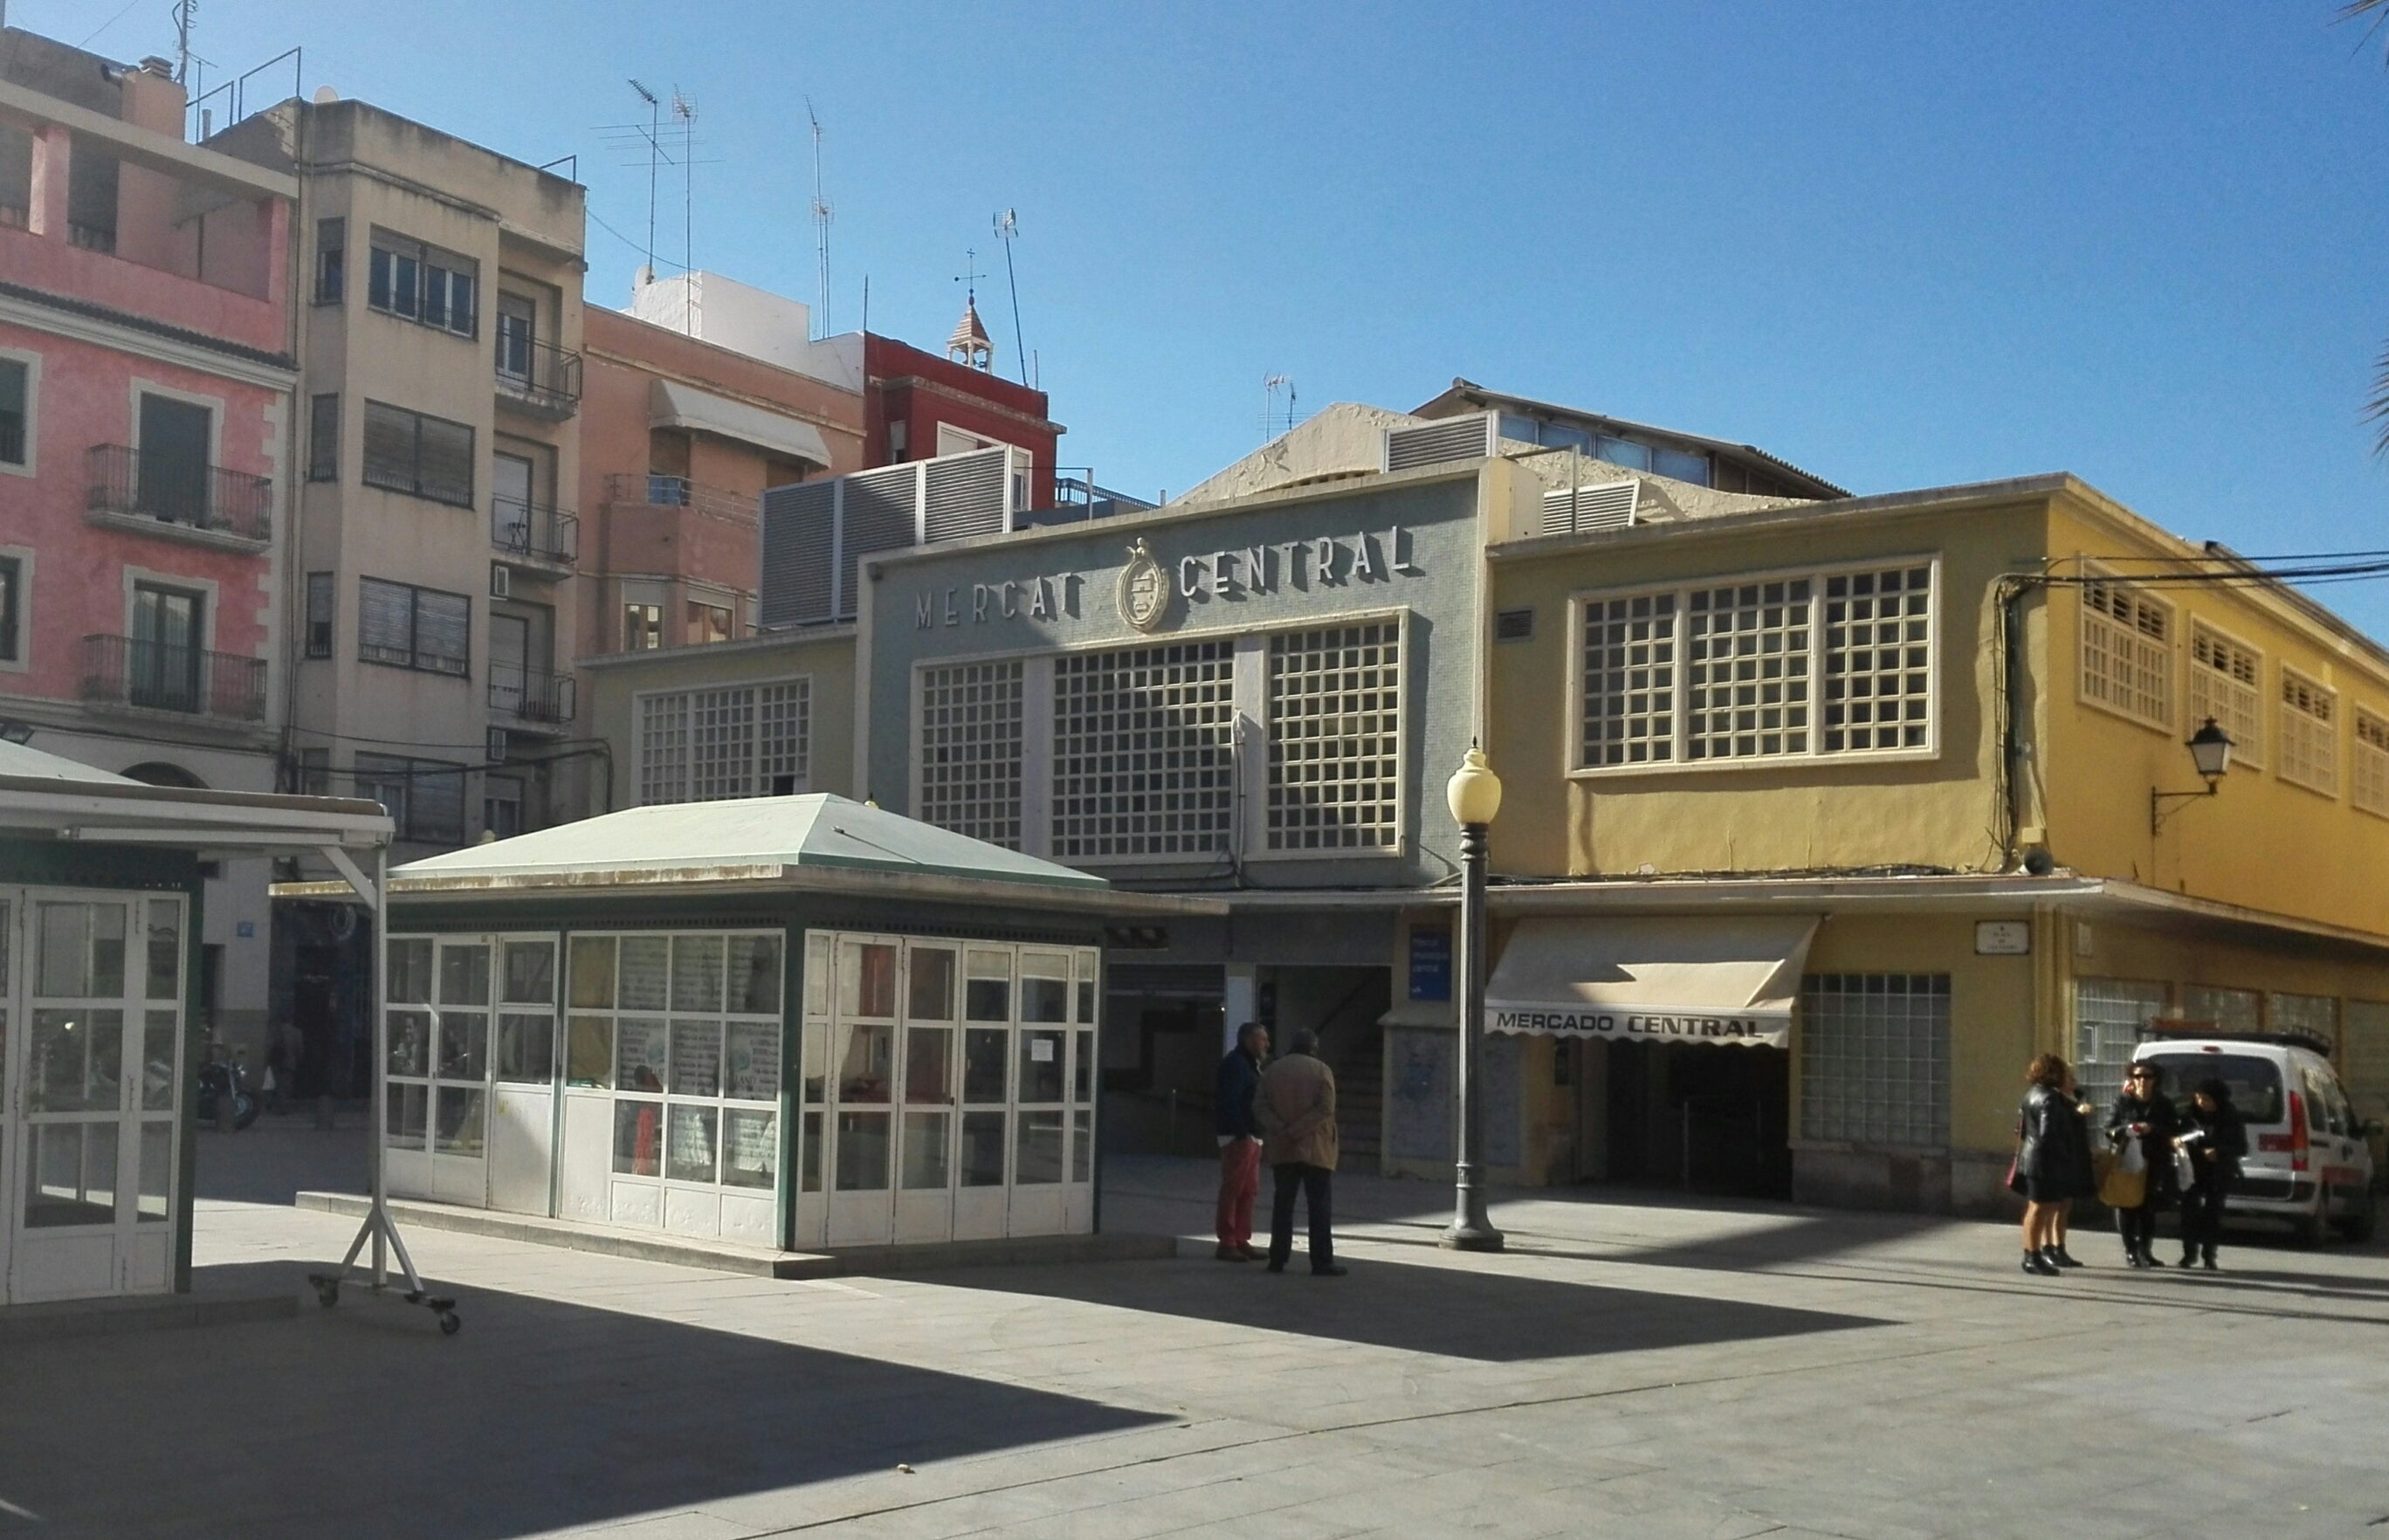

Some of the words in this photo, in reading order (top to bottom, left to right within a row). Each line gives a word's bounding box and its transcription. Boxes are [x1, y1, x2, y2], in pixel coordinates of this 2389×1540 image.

[917, 572, 1071, 629] MERCAT
[1180, 526, 1410, 597] CENTRAL
[1497, 1013, 1614, 1031] MERCADO
[1628, 1015, 1764, 1038] CENTRAL
